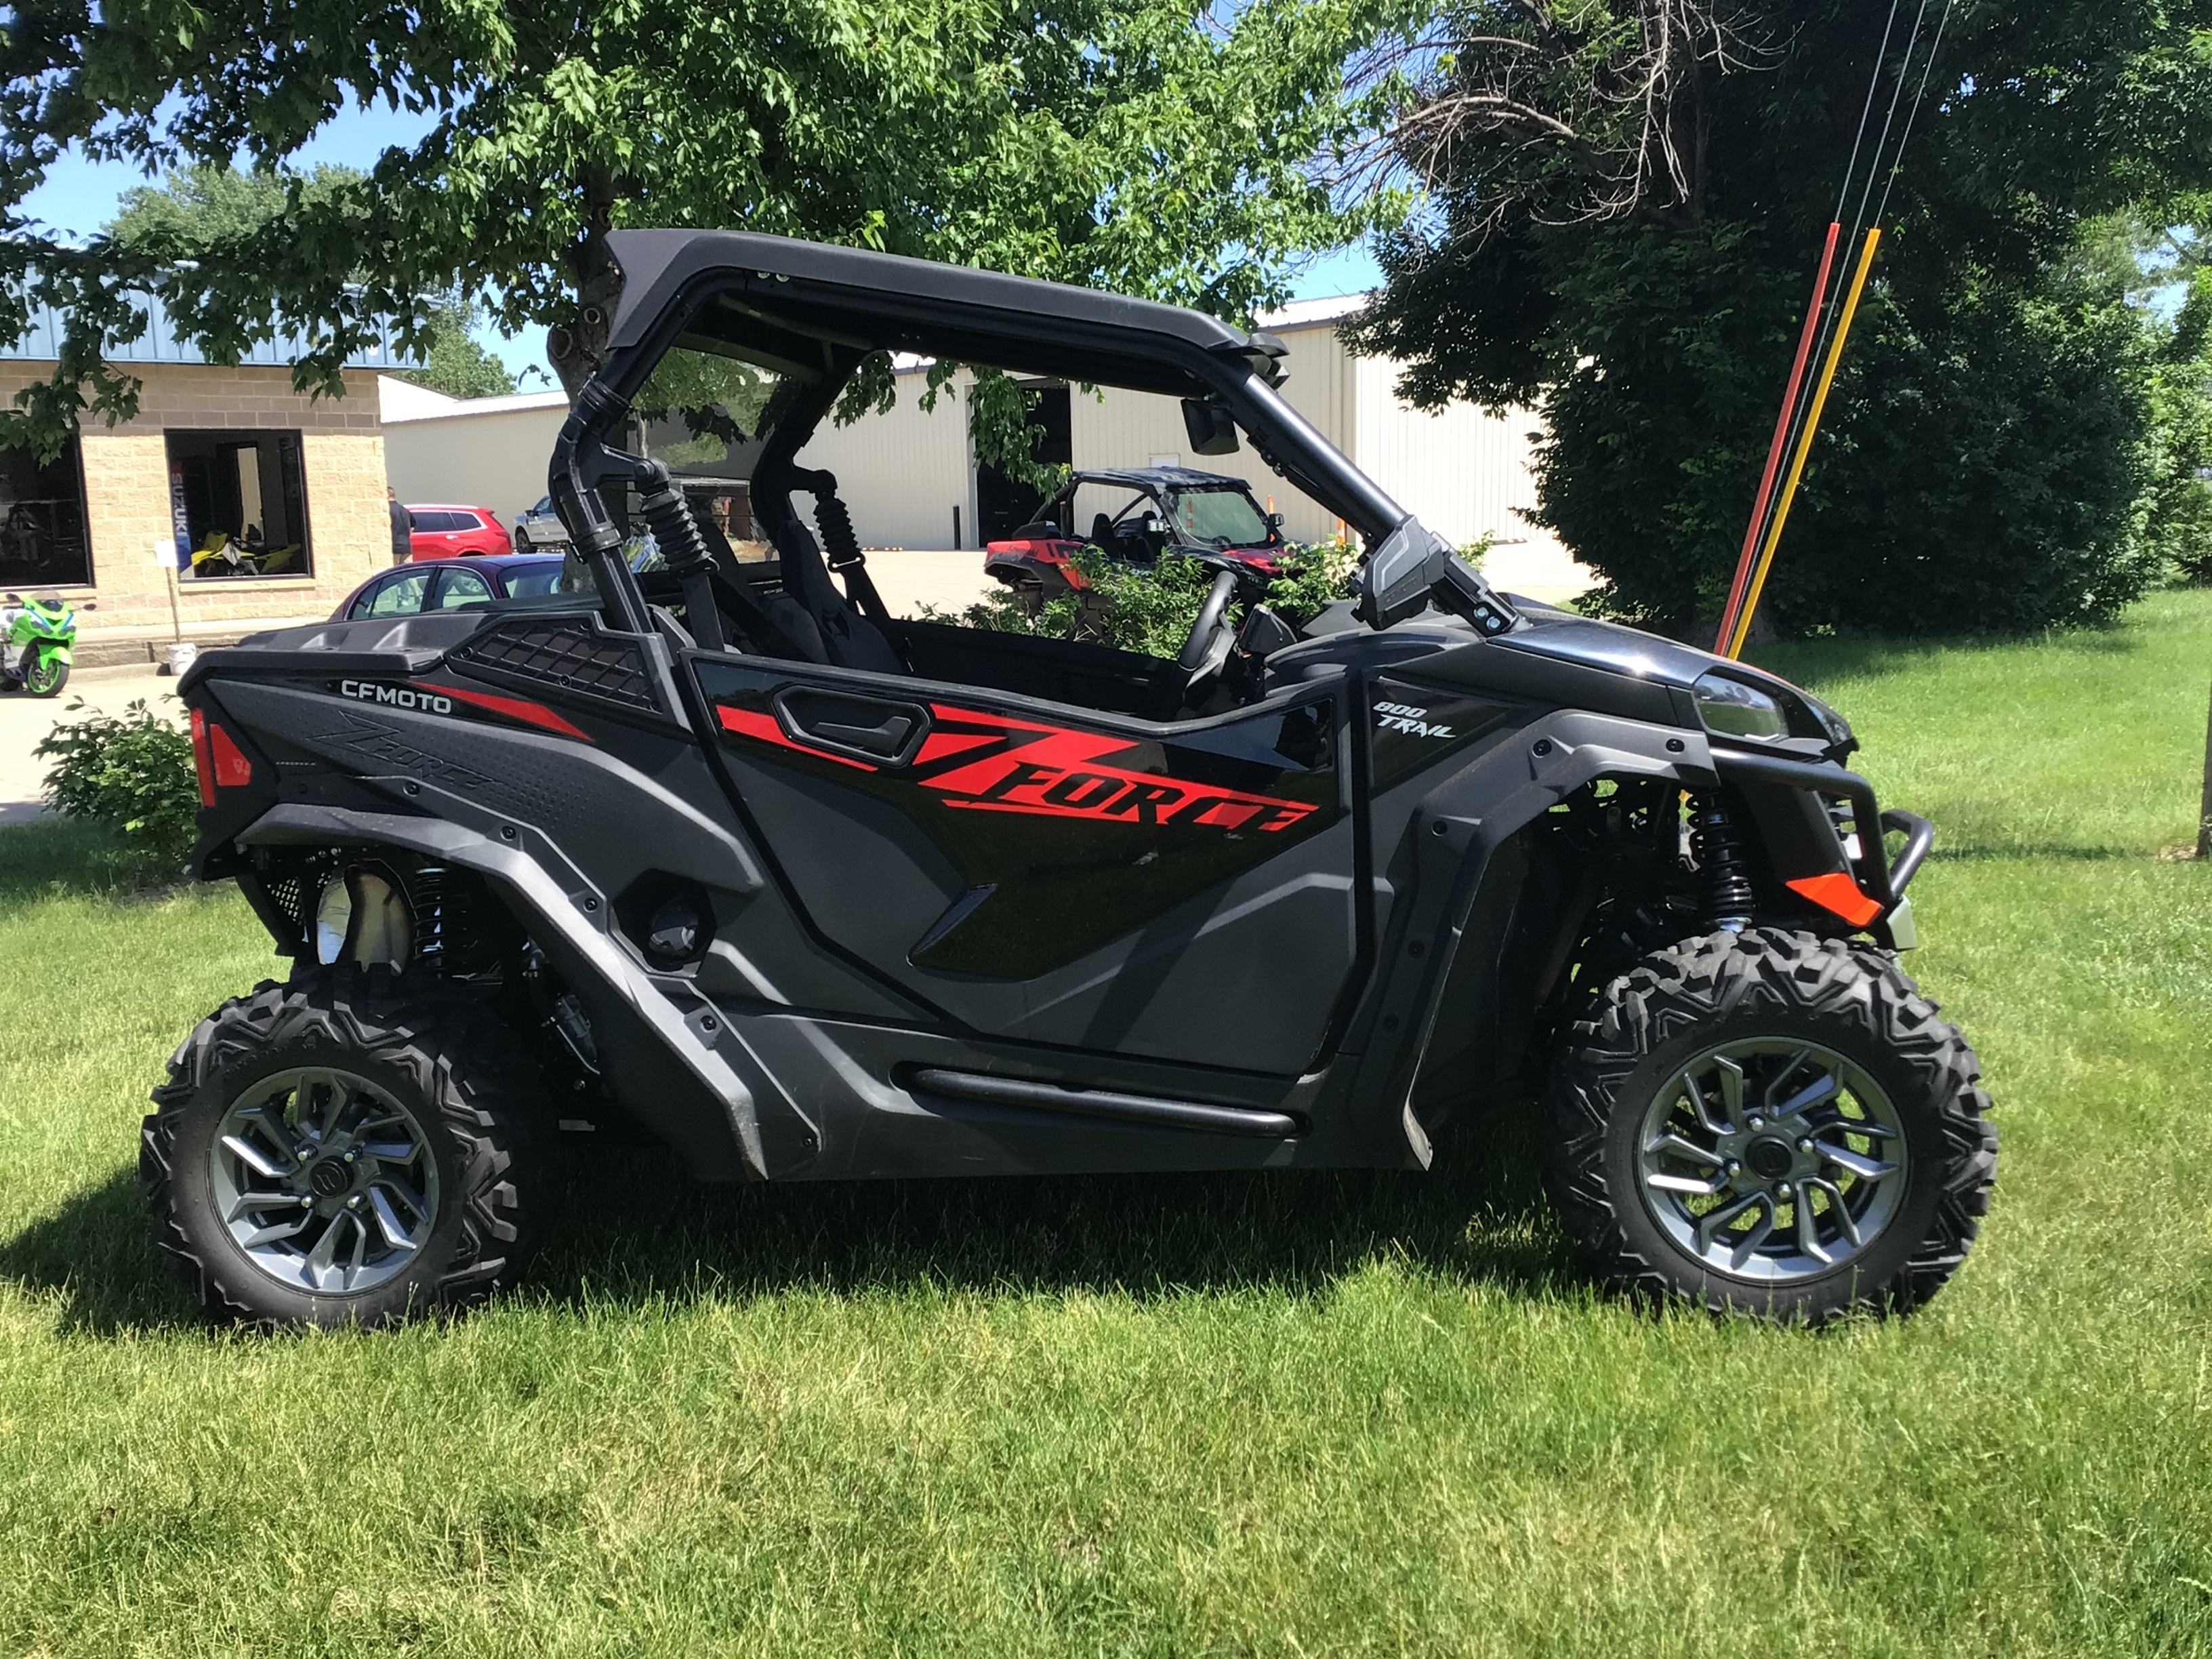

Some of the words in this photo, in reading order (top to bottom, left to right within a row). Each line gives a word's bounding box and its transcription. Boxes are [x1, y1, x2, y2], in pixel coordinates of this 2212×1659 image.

[171, 472, 188, 536] SUZUKI
[341, 679, 452, 714] CFMOTO
[1372, 701, 1429, 718] 800
[1377, 714, 1457, 739] TRAIL
